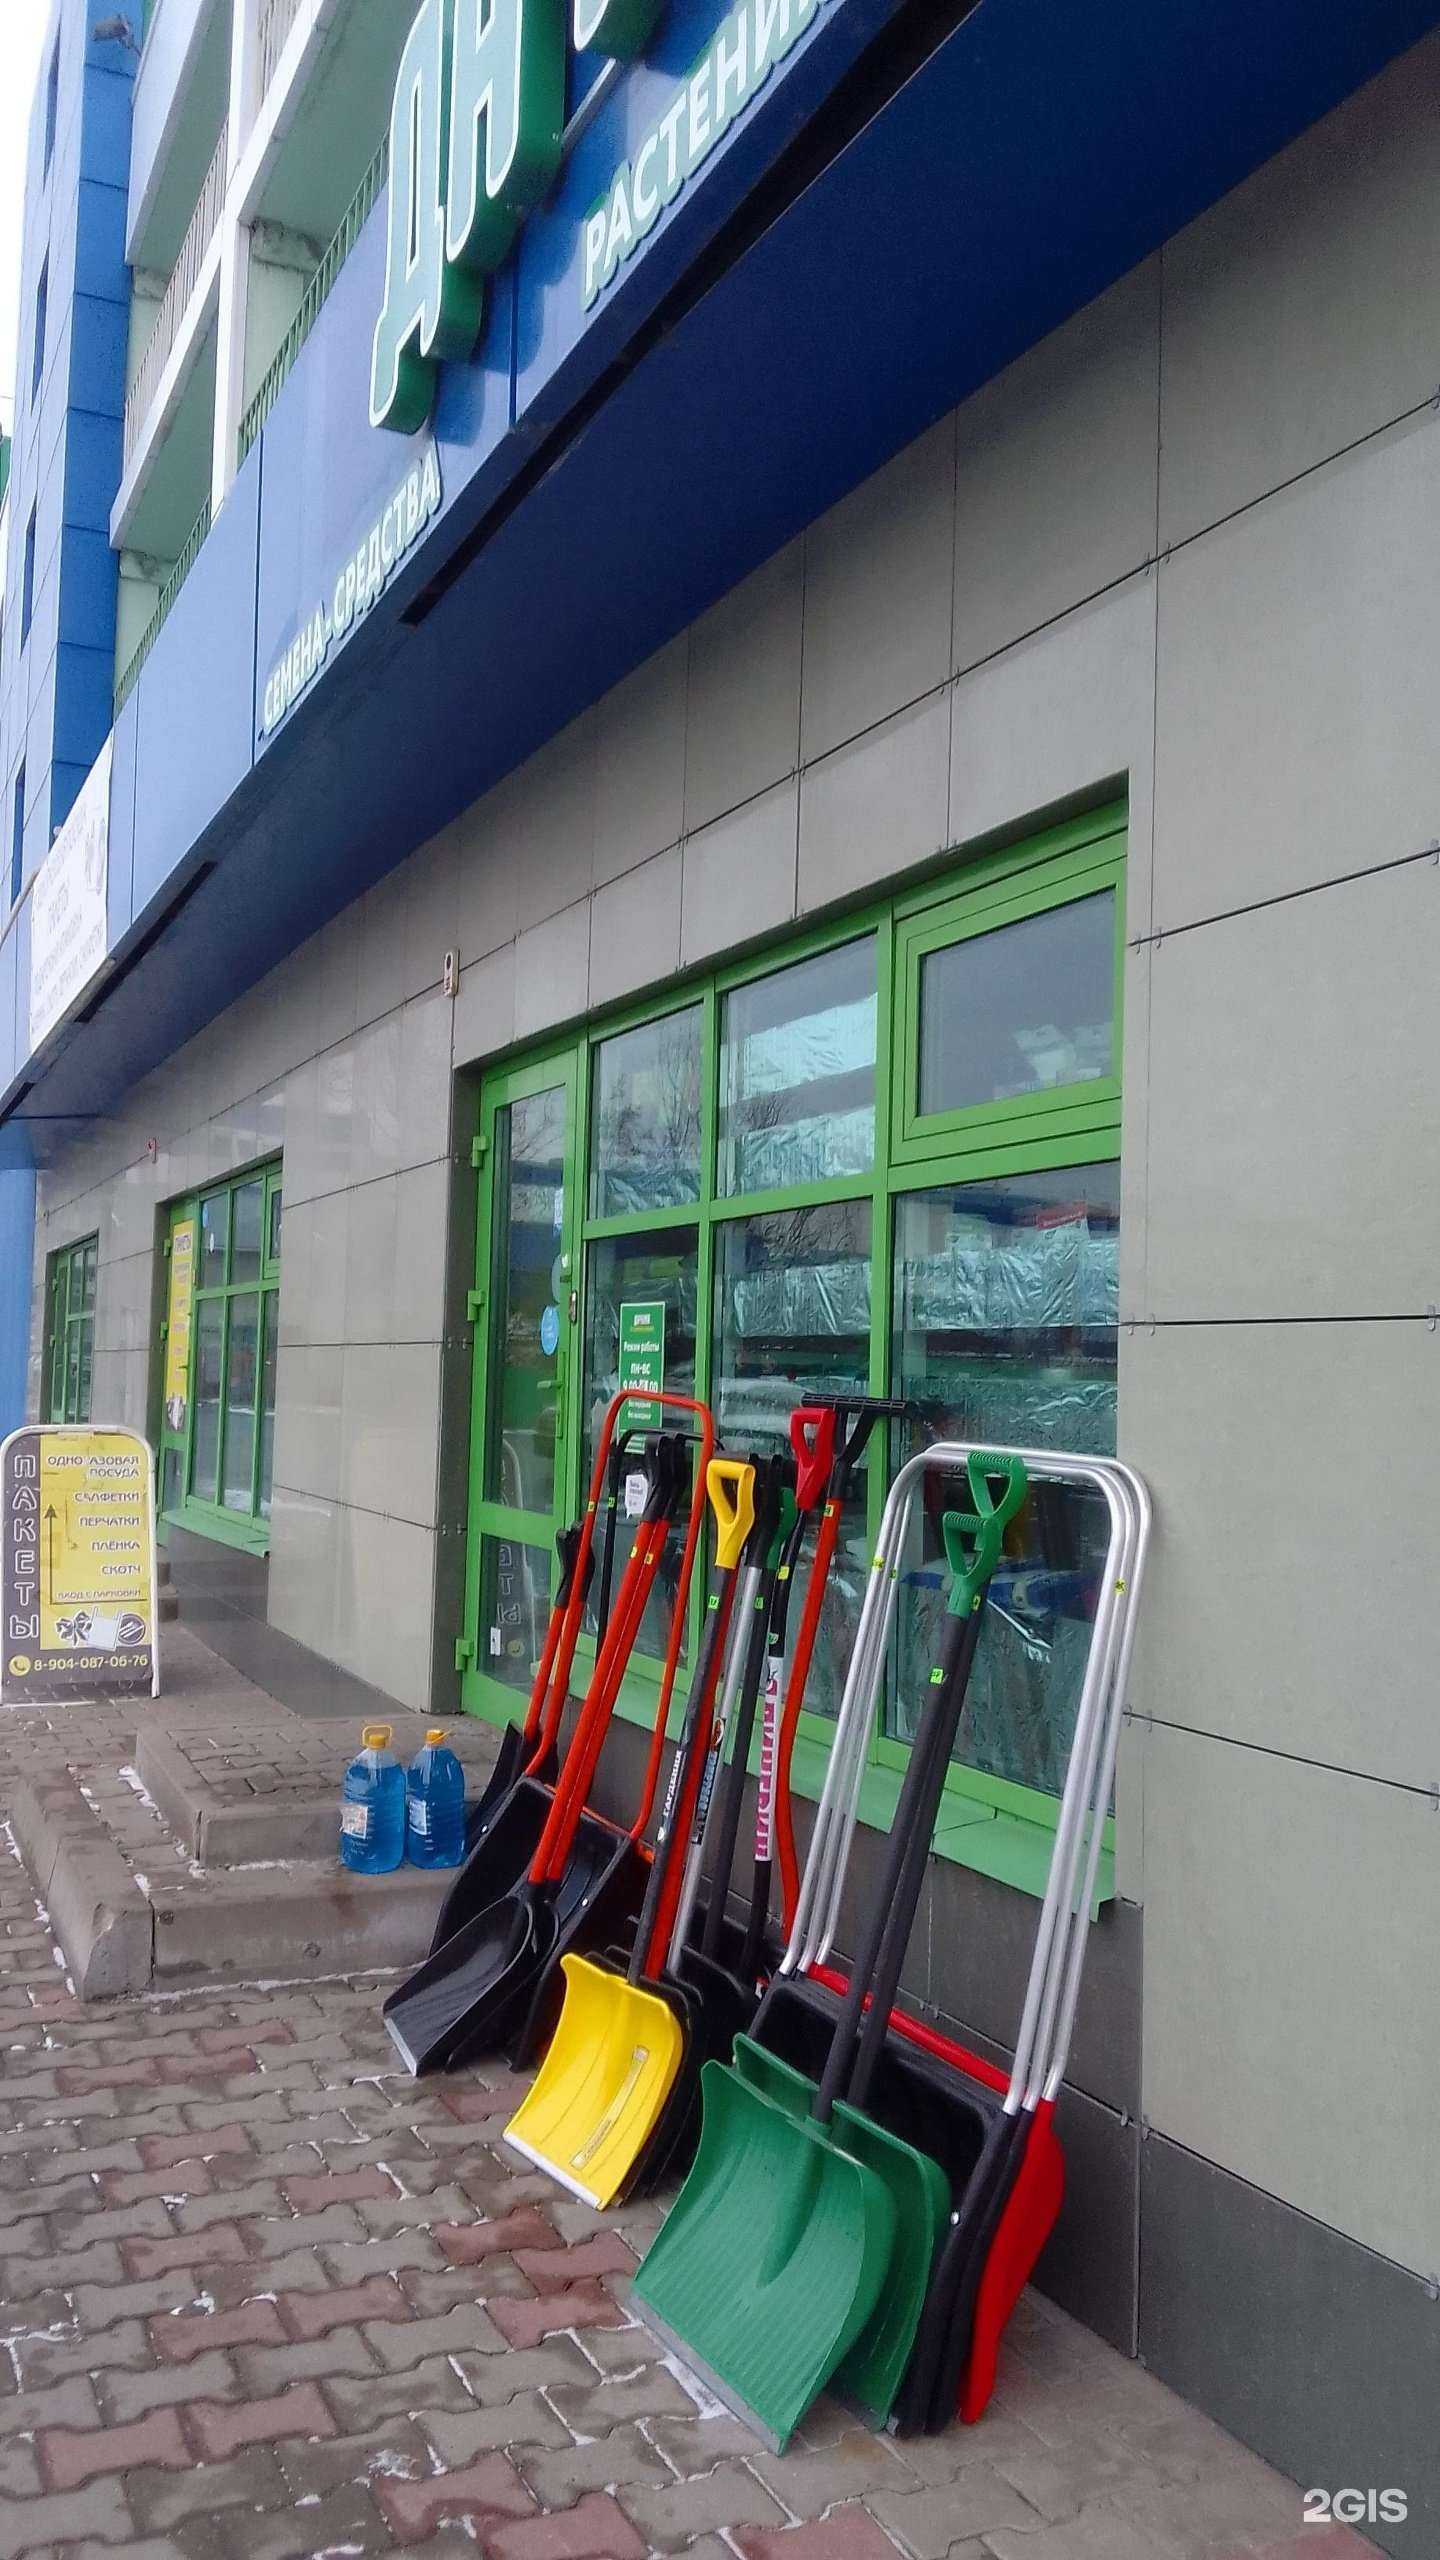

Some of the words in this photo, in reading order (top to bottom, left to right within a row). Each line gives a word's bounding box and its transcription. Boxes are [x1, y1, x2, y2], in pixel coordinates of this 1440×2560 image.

[585, 0, 809, 298] РАСТЕНИ
[264, 608, 325, 727] СЕМЕНА
[333, 449, 440, 627] СРЕДСТВА
[47, 1456, 140, 1467] ОДНОАЗОВАЯ
[89, 1468, 140, 1479] ПОСУДА
[75, 1492, 140, 1503] САЛФЕТКИ
[79, 1516, 140, 1527] ПЕРЧАТКИ
[10, 1455, 39, 1640] ПАКЕТЫ
[101, 1564, 141, 1575] СКОТЧ
